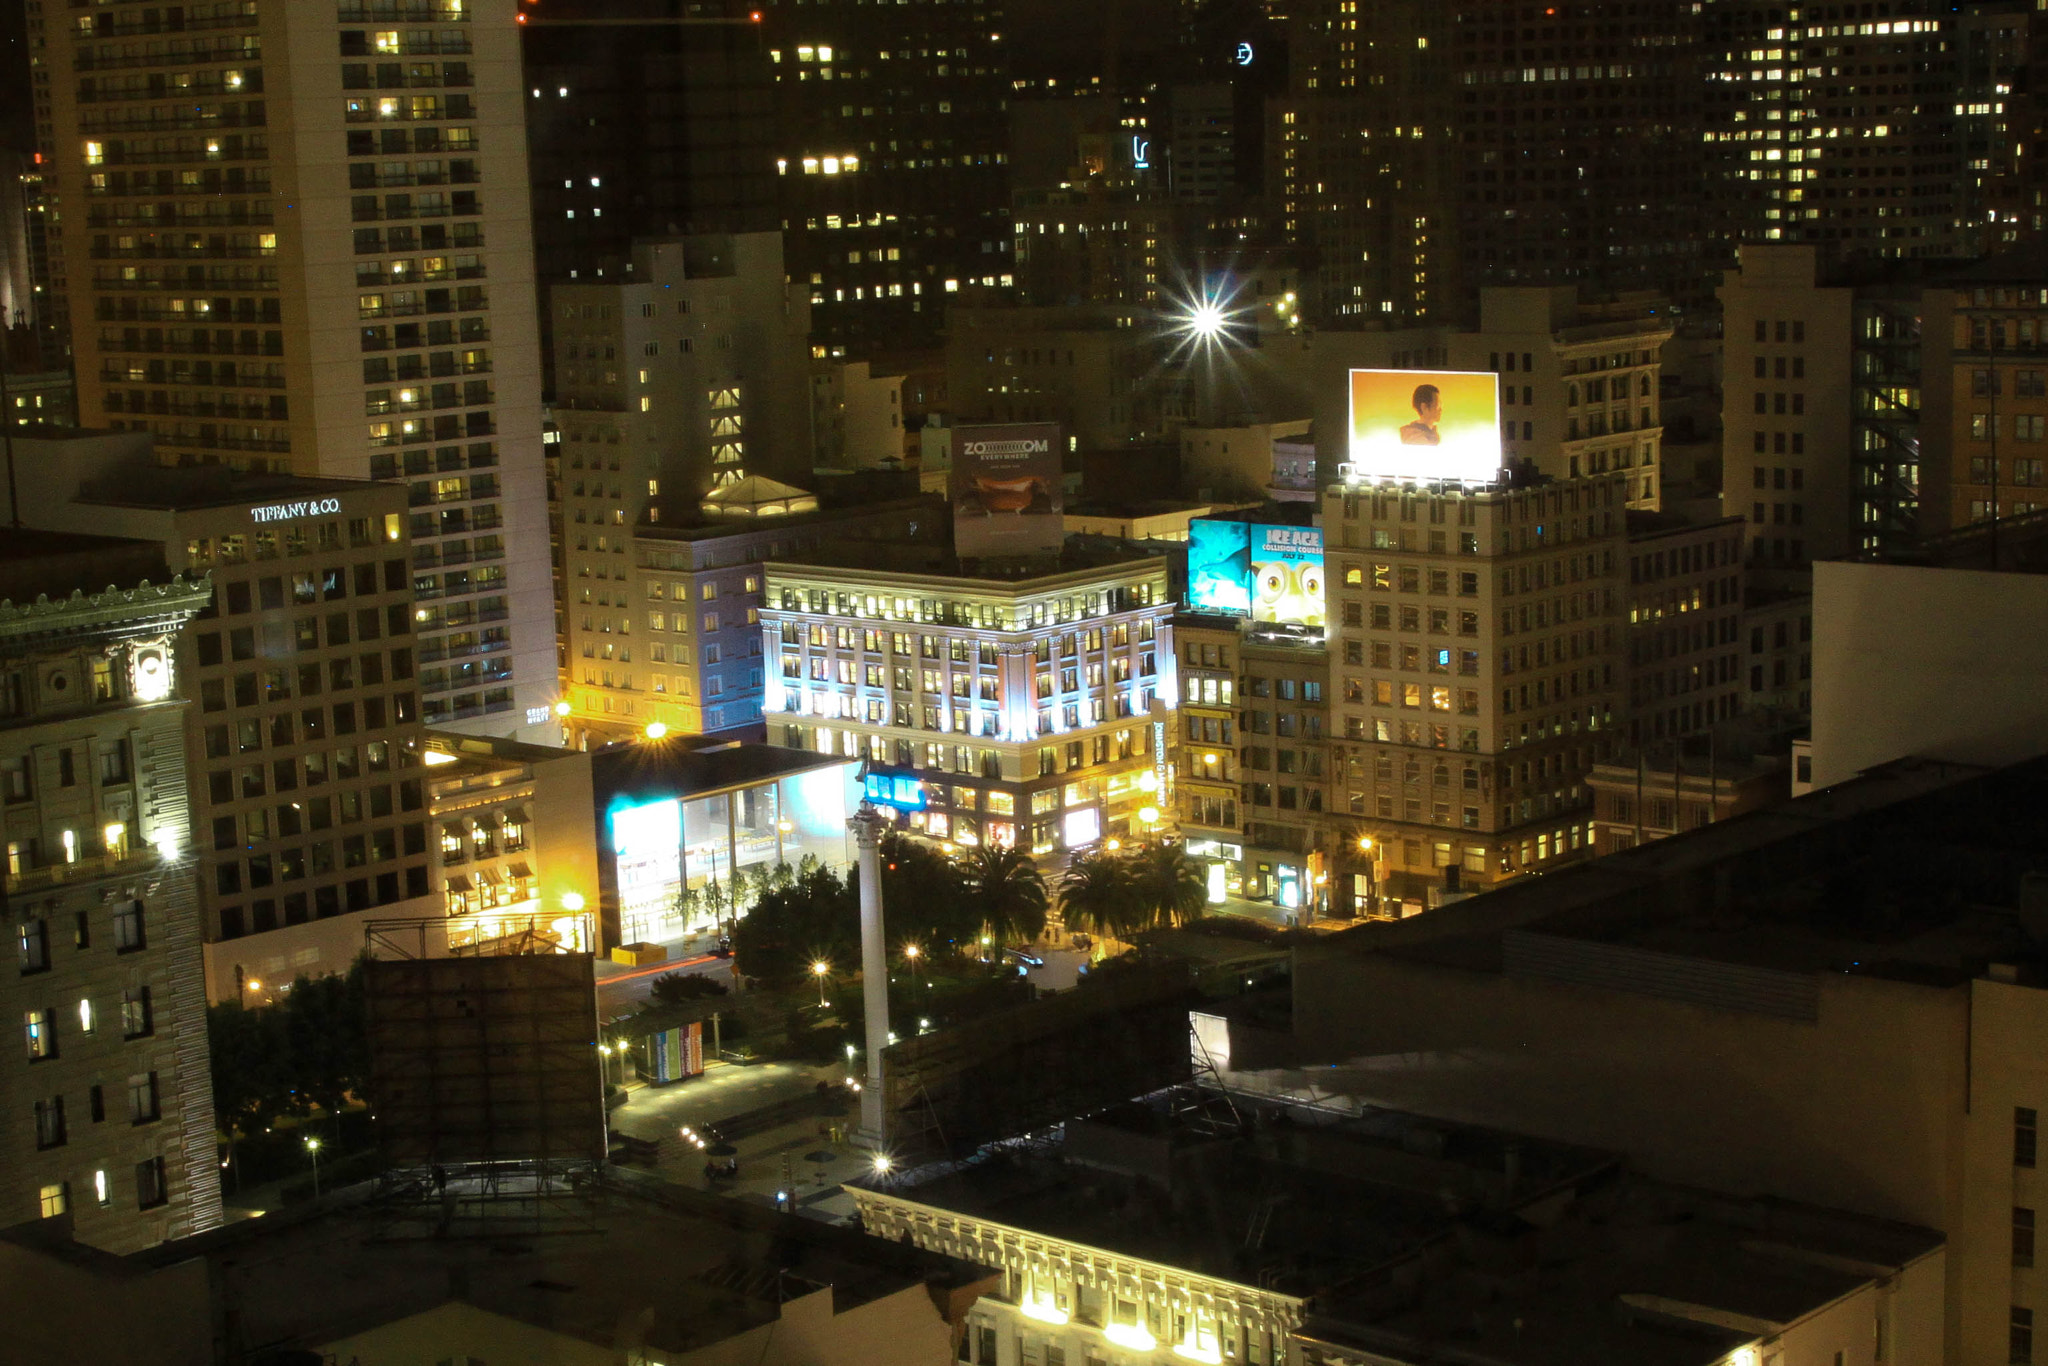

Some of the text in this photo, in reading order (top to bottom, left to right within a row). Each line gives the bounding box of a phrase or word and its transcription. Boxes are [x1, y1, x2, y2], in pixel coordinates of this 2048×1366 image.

[251, 502, 308, 522] TIFFANY
[310, 501, 320, 515] &
[1266, 529, 1319, 546] ICE AGE
[1262, 544, 1297, 552] COLLISION
[1153, 721, 1165, 764] JOHNSTON
